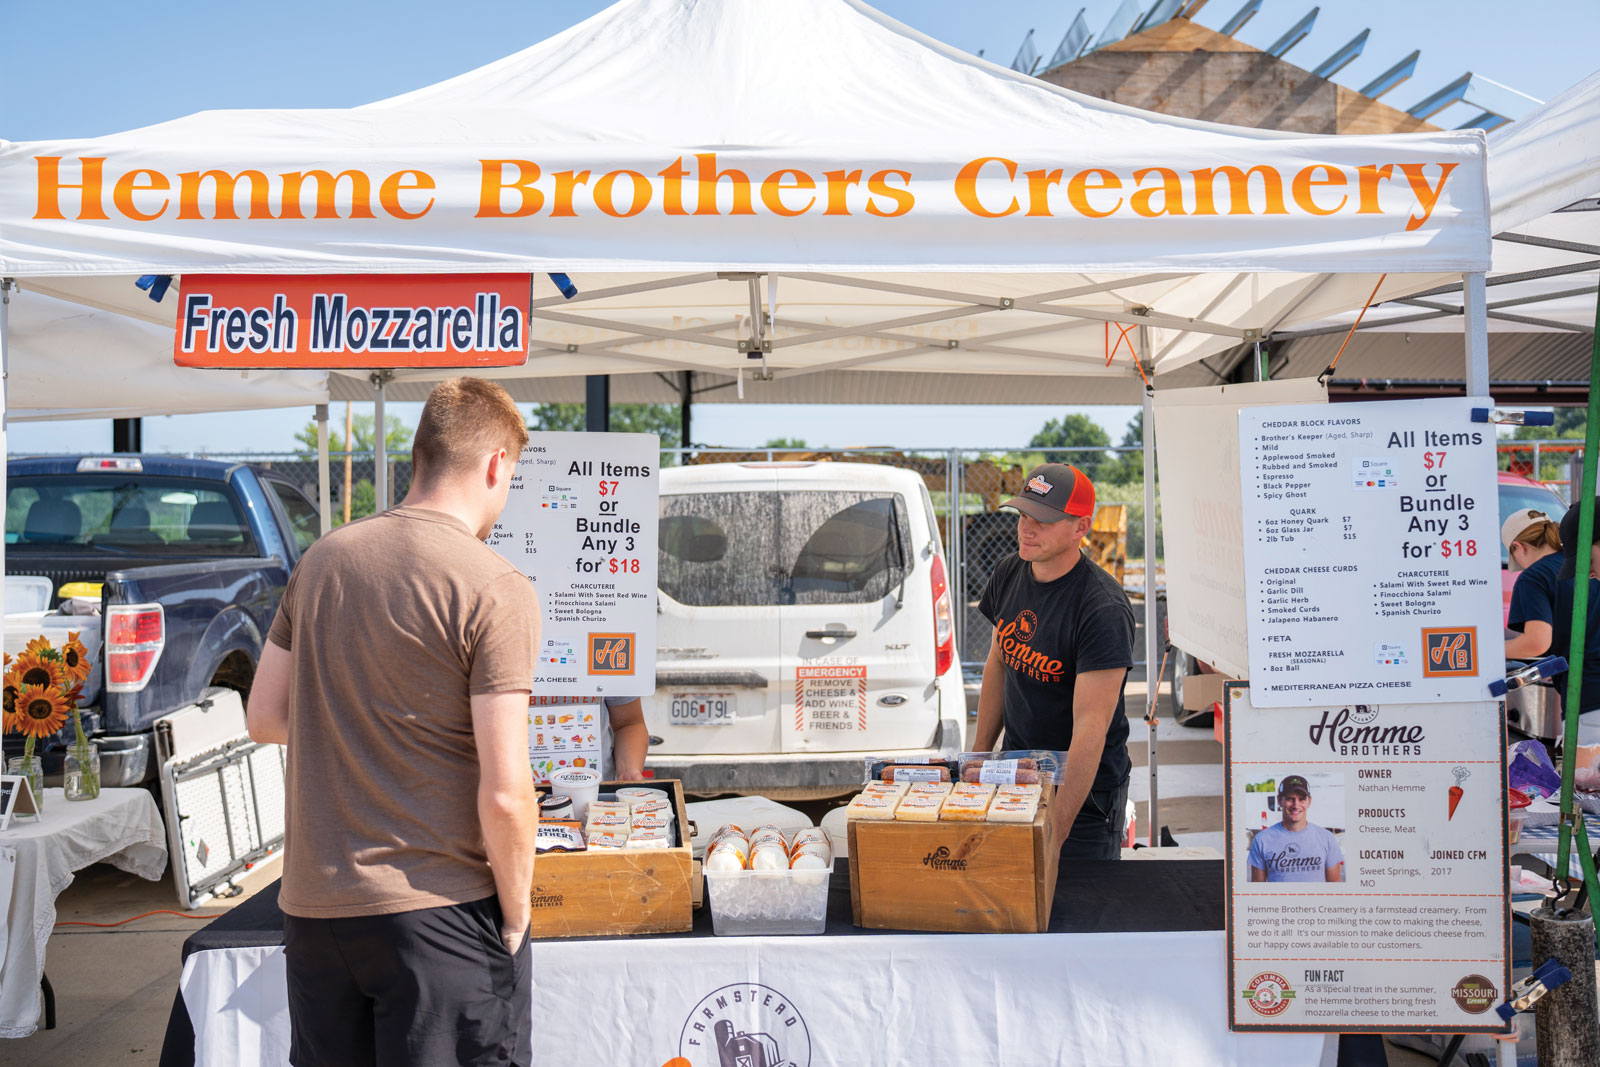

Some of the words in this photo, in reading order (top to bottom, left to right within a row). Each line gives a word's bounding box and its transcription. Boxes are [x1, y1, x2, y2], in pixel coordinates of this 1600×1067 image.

[33, 156, 435, 221] Hemme
[475, 153, 915, 218] Brothers
[955, 157, 1457, 231] Creamery
[183, 296, 296, 351] Fresh
[311, 295, 520, 350] Mozzarella
[1298, 434, 1323, 442] Keeper
[1350, 431, 1373, 440] Sharp)
[1387, 430, 1414, 448] All
[1425, 430, 1482, 447] Items
[1262, 453, 1304, 462] Applewood
[1424, 451, 1446, 470] $7
[568, 461, 592, 476] All
[601, 462, 650, 478] Items
[1286, 482, 1310, 490] Pepper
[1426, 474, 1448, 487] or
[599, 480, 619, 498] $7
[1264, 492, 1282, 500] Spicy
[600, 500, 618, 512] or
[1400, 494, 1474, 512] Bundle
[1290, 508, 1316, 516] QUARK
[576, 518, 640, 533] Bundle
[1281, 518, 1304, 526] Honey
[1408, 516, 1448, 536] Any
[1458, 514, 1469, 530] 3
[582, 536, 618, 554] Any
[625, 536, 634, 551] 3
[1402, 542, 1432, 558] for
[1441, 540, 1477, 559] $18
[576, 558, 602, 572] for
[609, 556, 640, 574] $18
[1382, 610, 1410, 618] Spanish
[816, 658, 842, 666] CASE
[799, 668, 864, 676] EMERGENCY
[1005, 654, 1061, 682] BROTHERS
[806, 688, 846, 697] CHEESE
[672, 700, 698, 718] GD6
[706, 700, 732, 718] T9L
[829, 700, 858, 709] WINE,
[810, 722, 852, 730] FRIENDS
[1309, 709, 1424, 752] Hemme
[1341, 746, 1421, 756] BROTHERS
[1358, 770, 1392, 778] OWNER
[1358, 784, 1388, 792] Nathan
[1392, 784, 1426, 792] Hemme
[1358, 808, 1406, 818] PRODUCTS
[1359, 825, 1392, 834] Cheese,
[1394, 824, 1416, 833] Meat
[923, 853, 967, 868] Hemme
[1360, 850, 1404, 860] LOCATION
[1430, 850, 1464, 860] JOINED
[1468, 850, 1487, 860] CFM
[1265, 852, 1322, 870] Hemme
[1360, 867, 1385, 876] Sweet
[1387, 867, 1422, 878] Springs,
[1431, 867, 1452, 876] 2017
[1318, 906, 1358, 914] Creamery
[1420, 907, 1461, 916] creamery.
[1252, 974, 1286, 988] COLUMBIA
[1304, 970, 1320, 982] FUN
[1323, 970, 1344, 982] FACT
[1323, 986, 1351, 994] special
[1452, 988, 1497, 998] MISSOURI
[1392, 998, 1414, 1006] bring
[689, 990, 797, 1046] FARMSTEAD
